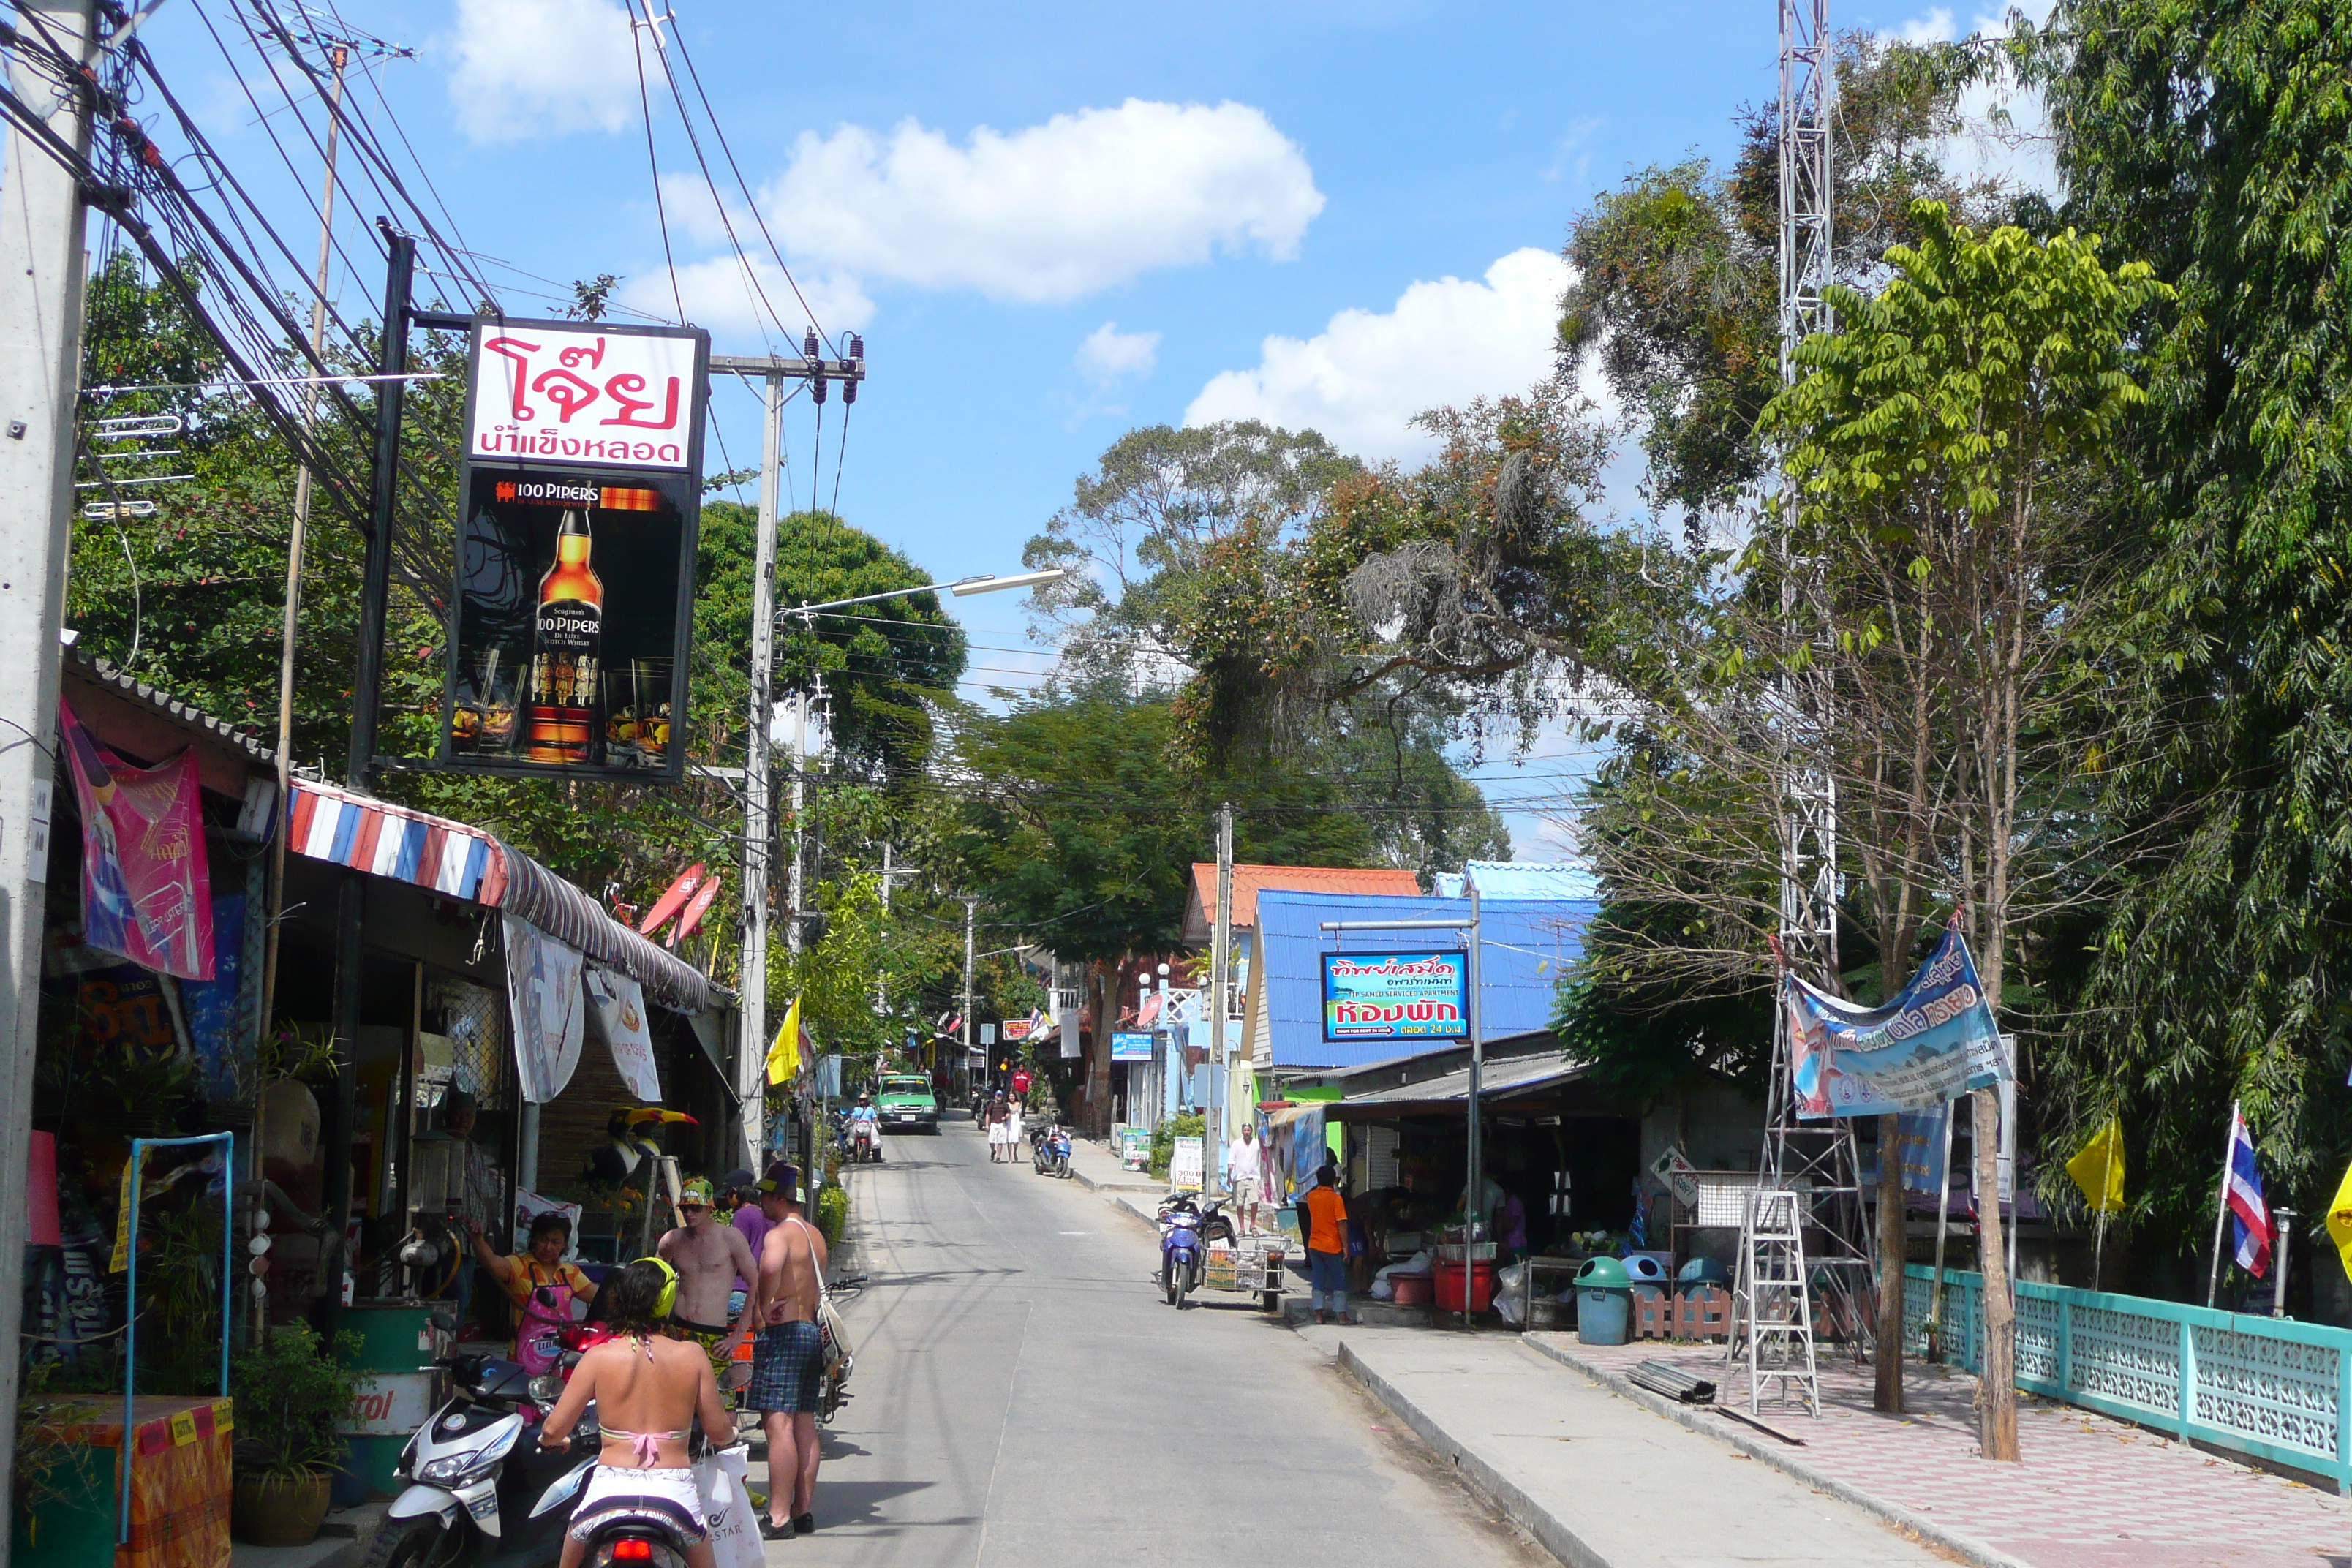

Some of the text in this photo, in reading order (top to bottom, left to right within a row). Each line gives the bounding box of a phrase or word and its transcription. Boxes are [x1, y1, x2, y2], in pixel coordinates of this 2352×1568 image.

[480, 425, 680, 462] น้ำแข็งหลอด
[518, 483, 598, 501] 100 PIPERS
[538, 617, 599, 633] 100 PIPERS
[1336, 999, 1458, 1022] ห้องพัก
[1431, 1024, 1442, 1033] 24
